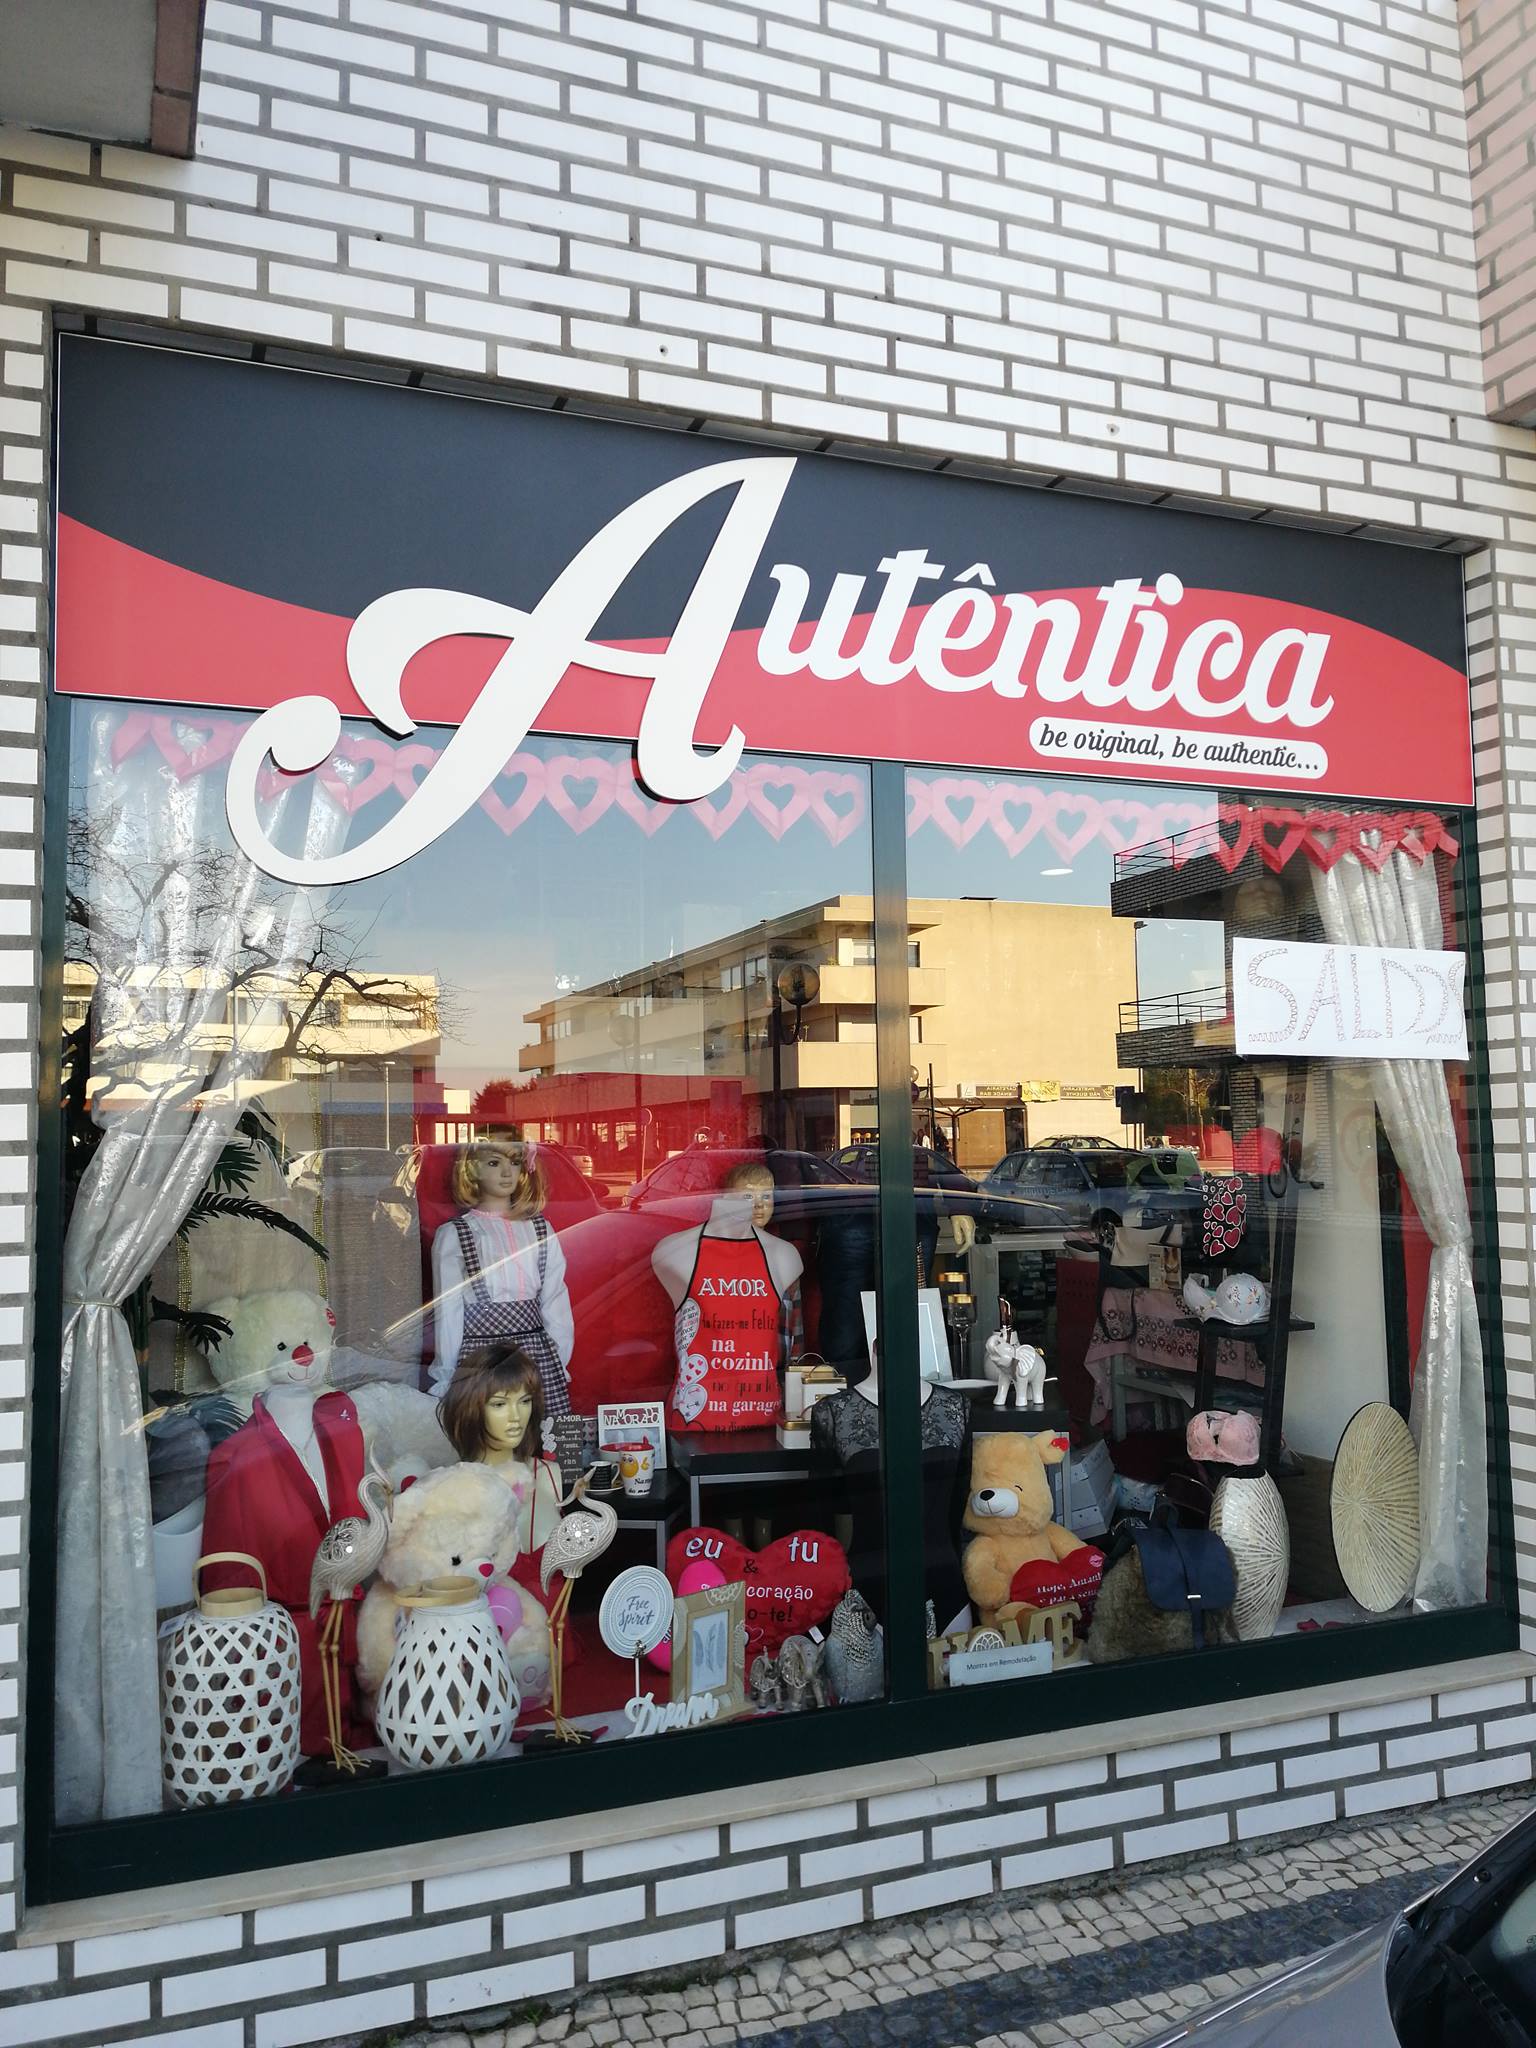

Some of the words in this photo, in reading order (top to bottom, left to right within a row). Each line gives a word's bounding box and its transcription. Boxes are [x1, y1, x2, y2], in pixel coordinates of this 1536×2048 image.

[226, 457, 1335, 885] Autêntica
[1039, 723, 1068, 748] be
[1073, 728, 1165, 760] original,
[1172, 735, 1199, 759] be
[1203, 741, 1319, 770] authentic...
[697, 1277, 769, 1297] AMOR
[711, 1339, 736, 1352] na
[711, 1351, 774, 1371] cozinh
[708, 1400, 727, 1412] na
[731, 1400, 780, 1417] garage
[556, 1415, 582, 1423] AMOR
[686, 1537, 724, 1559] eu
[743, 1559, 759, 1574] &
[788, 1536, 819, 1563] tu
[626, 1595, 650, 1611] Free
[746, 1585, 814, 1603] coração
[747, 1605, 794, 1623] o-te!
[966, 1662, 988, 1671] Montra
[989, 1660, 998, 1668] em
[625, 1692, 720, 1738] Dream
